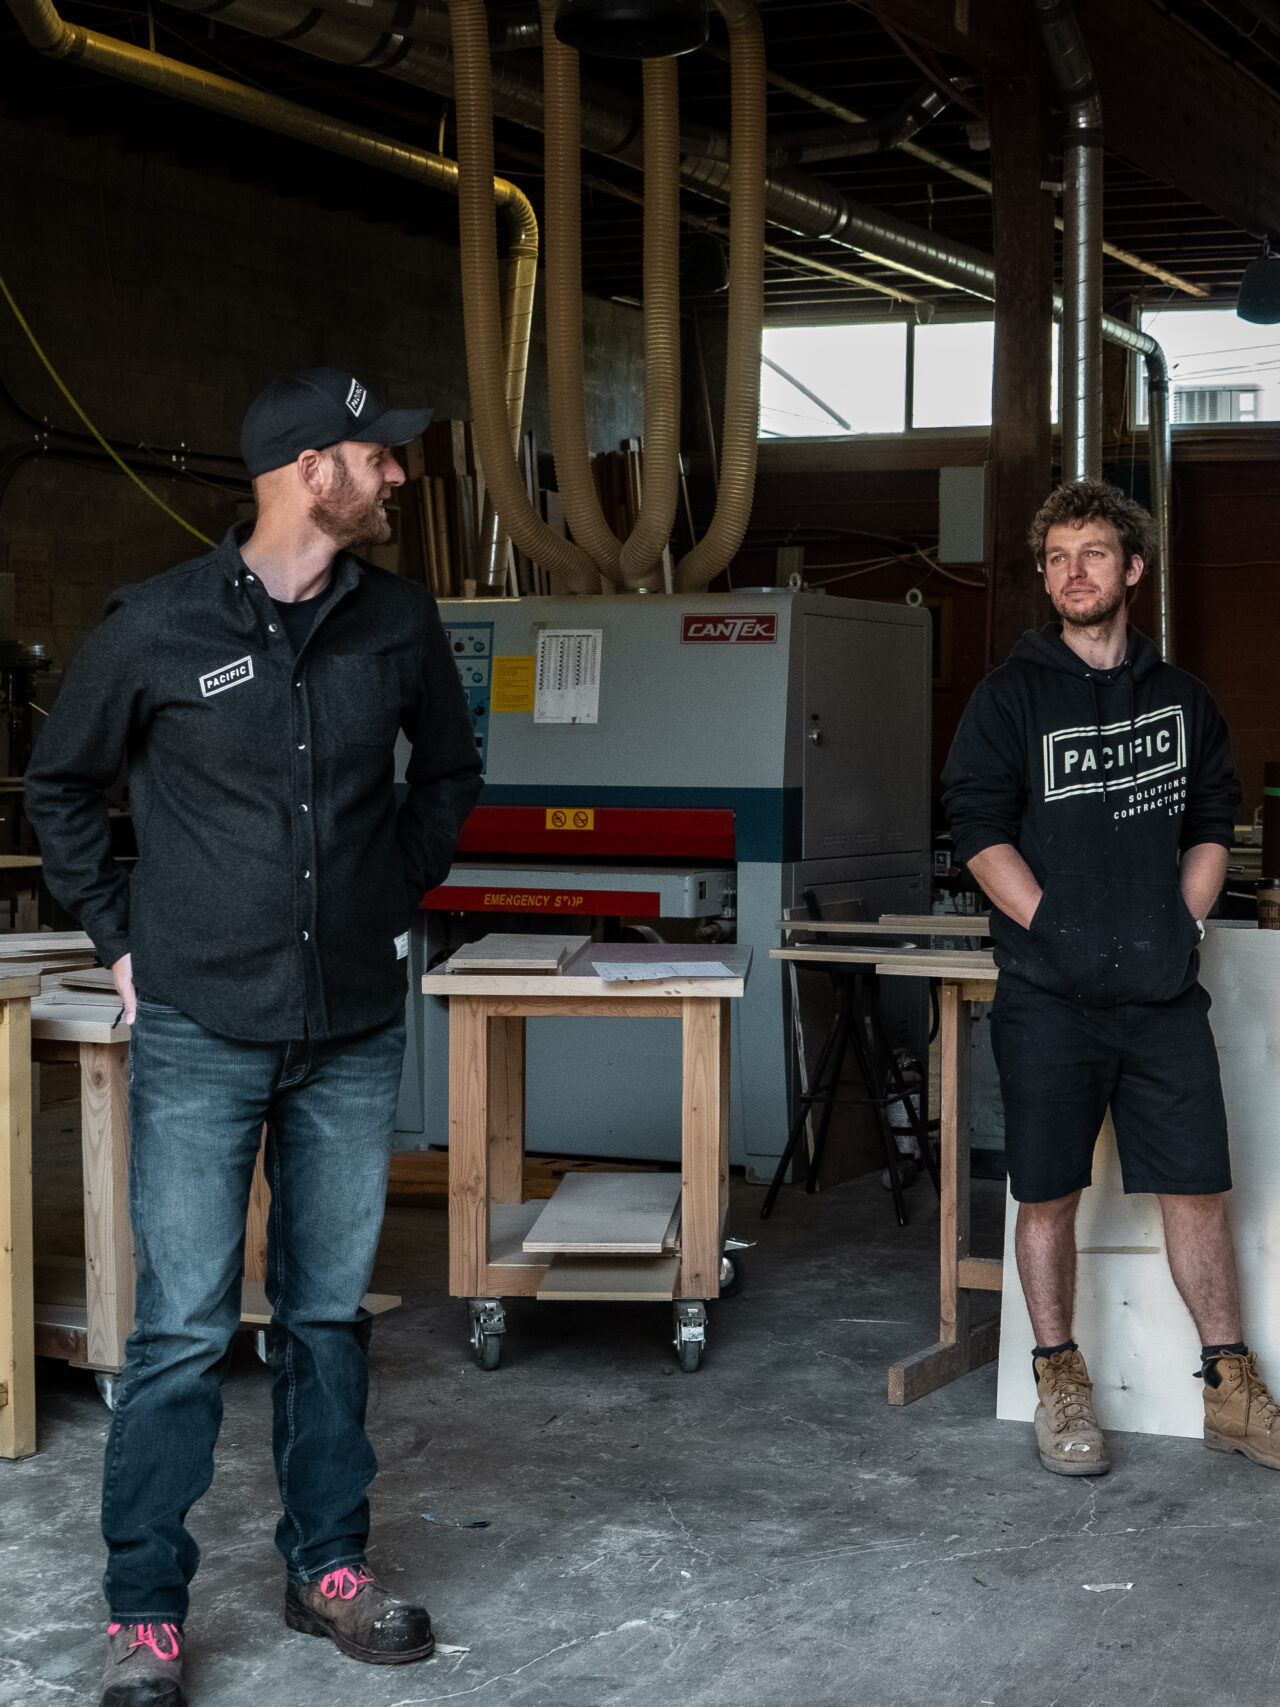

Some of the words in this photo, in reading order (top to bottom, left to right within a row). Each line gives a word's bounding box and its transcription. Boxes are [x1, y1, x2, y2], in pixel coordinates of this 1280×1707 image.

[687, 618, 776, 643] CANTEK
[206, 665, 246, 689] PACIFIC
[1064, 729, 1171, 774] PACIFIC
[1128, 776, 1187, 803] SOLUTIONS
[1113, 790, 1186, 820] CONTRACTING
[1168, 803, 1186, 817] LTD
[484, 893, 551, 907] EMERGENCY
[554, 895, 584, 907] STOP
